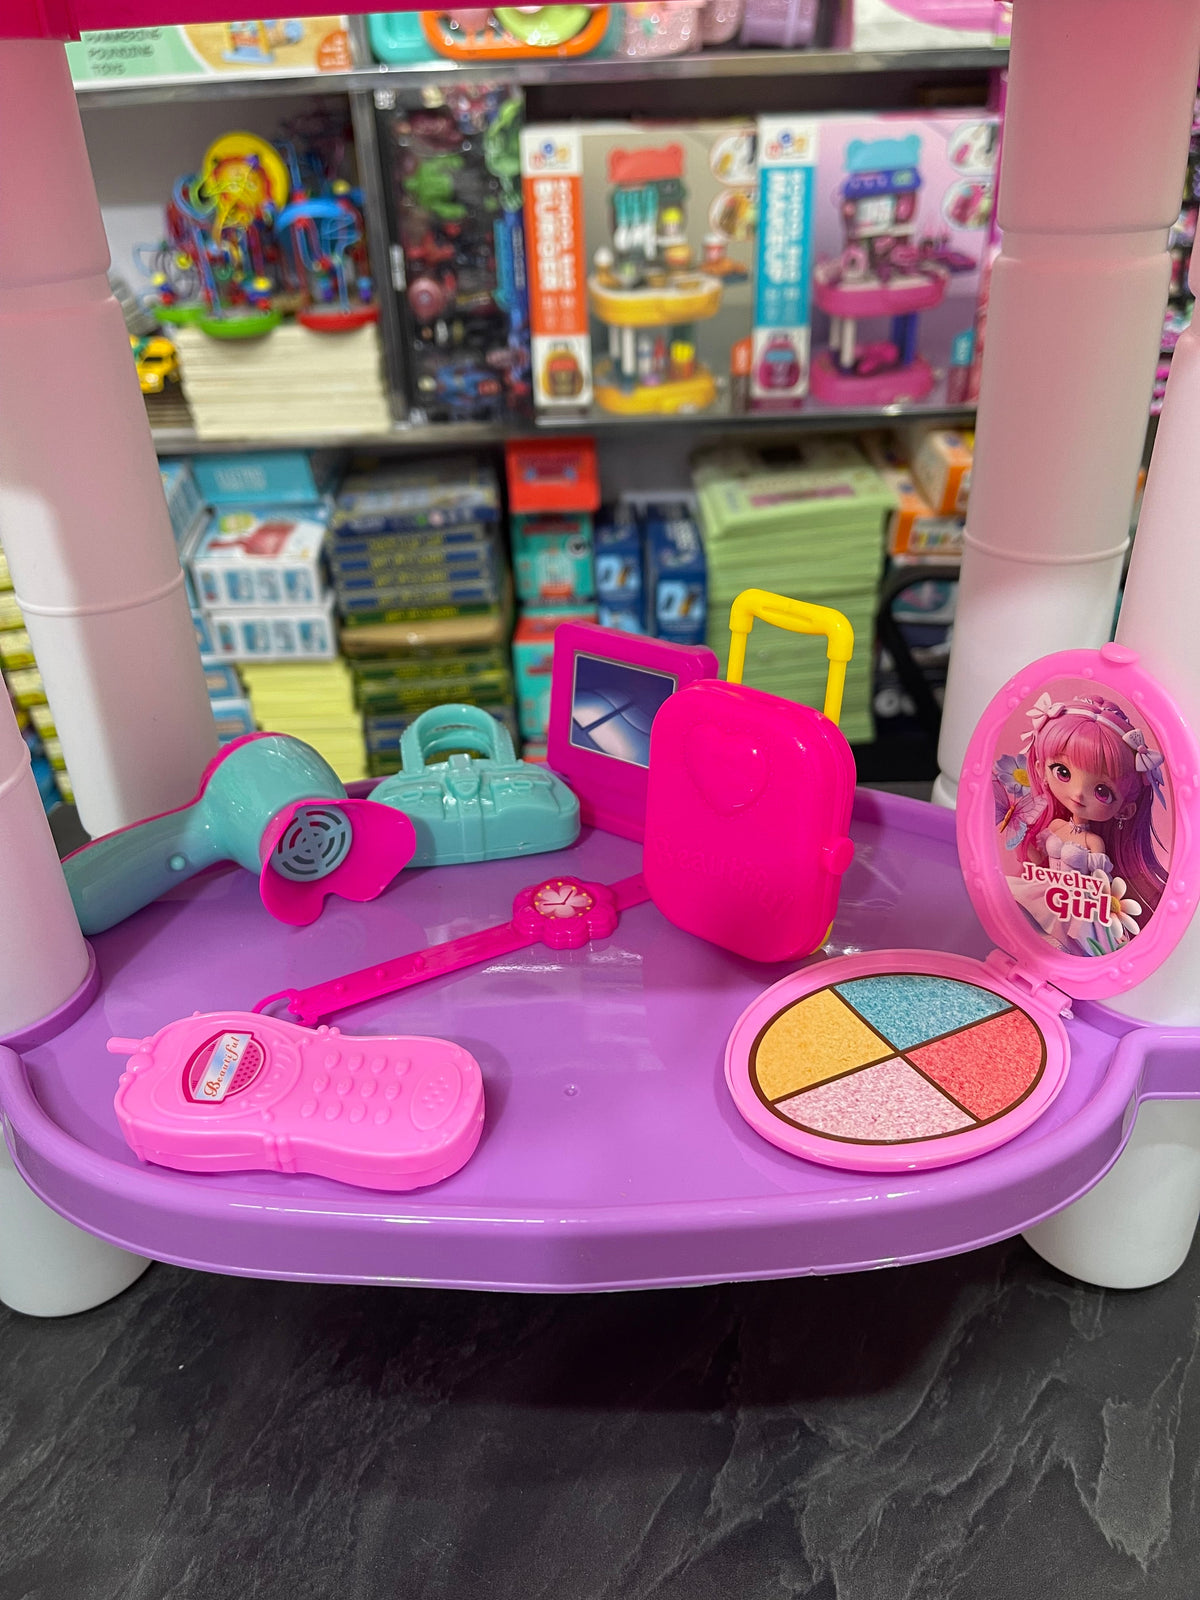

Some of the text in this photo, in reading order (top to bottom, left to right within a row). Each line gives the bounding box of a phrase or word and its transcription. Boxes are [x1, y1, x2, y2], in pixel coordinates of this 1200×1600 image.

[534, 181, 558, 291] BURGER
[1022, 863, 1104, 897] Jewelry
[1045, 886, 1110, 925] Girl
[203, 1036, 241, 1097] Beautiful
